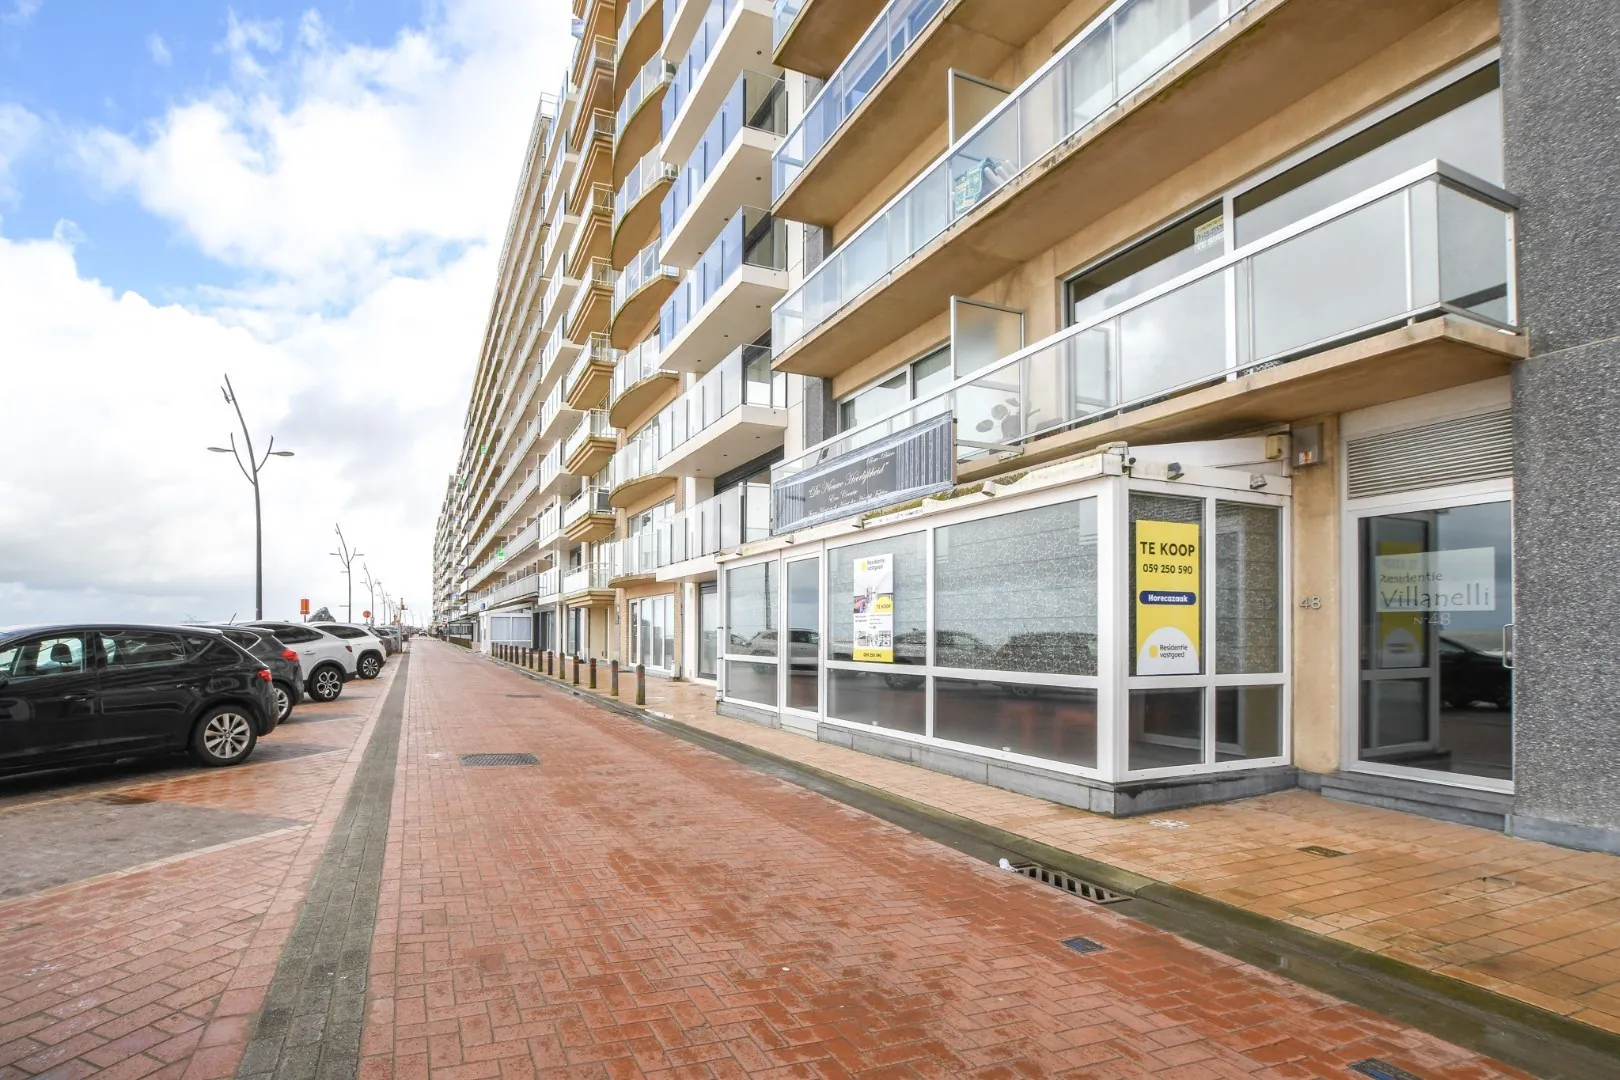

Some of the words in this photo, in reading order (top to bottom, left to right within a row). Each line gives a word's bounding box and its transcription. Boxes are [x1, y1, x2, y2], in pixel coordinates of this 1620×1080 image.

[1140, 542, 1155, 555] TE
[1160, 542, 1195, 557] KOOP
[1143, 563, 1158, 573] 059
[1160, 564, 1176, 574] 250
[1178, 565, 1193, 574] 590
[1380, 571, 1443, 584] Residentie
[1148, 594, 1188, 603] Horecazaak
[1380, 583, 1489, 608] Villanelli
[1300, 596, 1321, 609] 48
[1428, 612, 1452, 626] 48
[1160, 651, 1185, 659] vastgoed
